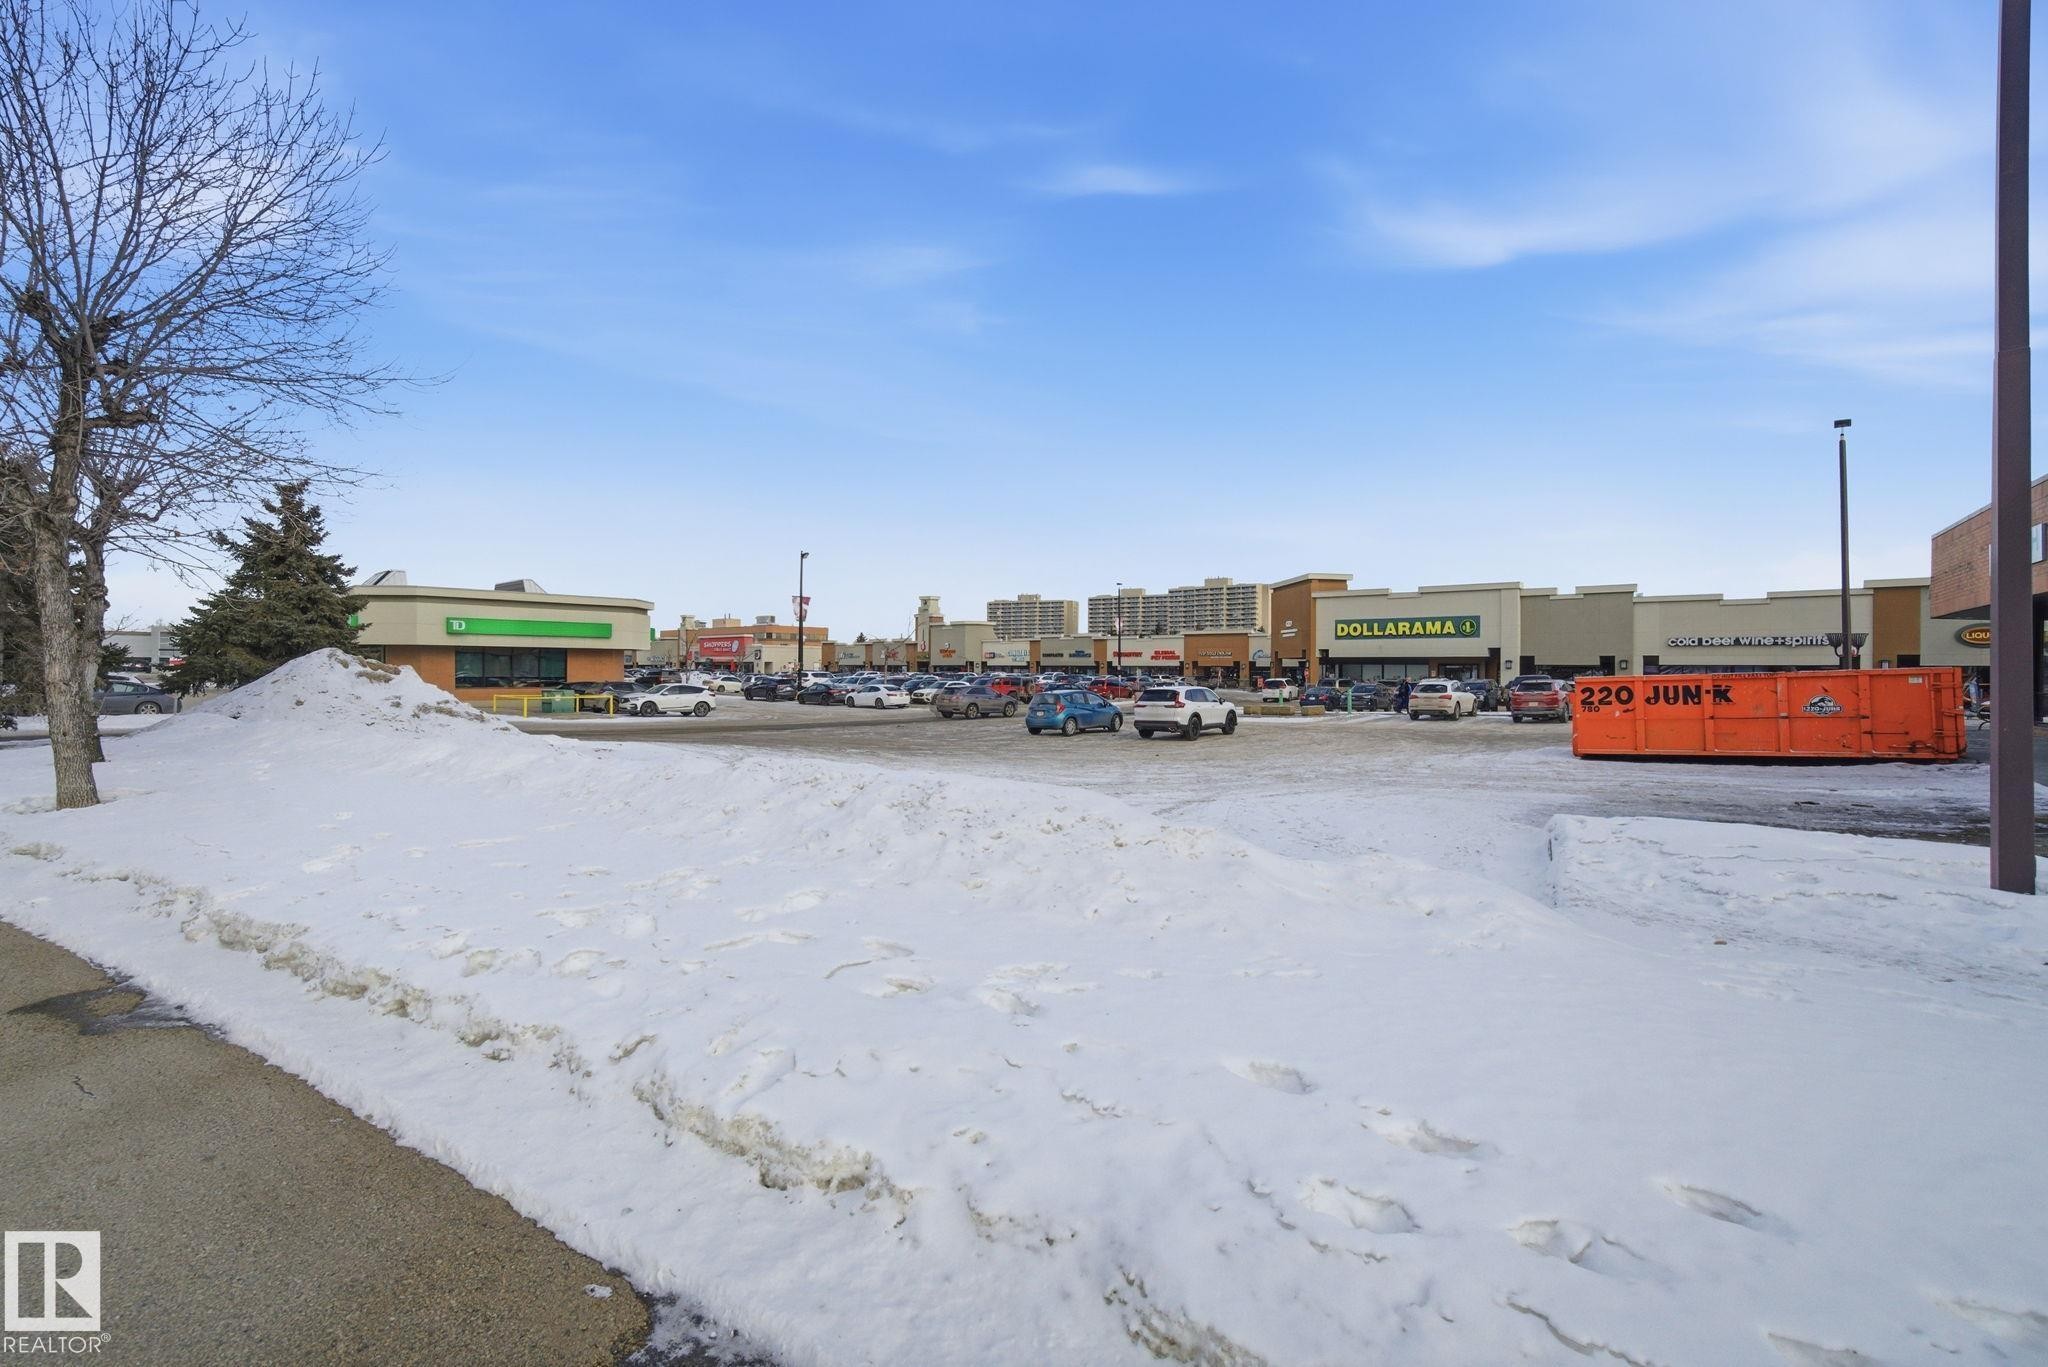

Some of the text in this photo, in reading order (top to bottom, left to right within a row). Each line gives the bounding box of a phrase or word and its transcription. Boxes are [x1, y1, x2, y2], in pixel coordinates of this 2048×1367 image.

[450, 620, 466, 631] TD
[1337, 621, 1455, 636] DOLLARAMA
[1668, 635, 1698, 647] cold
[1702, 635, 1736, 646] beer
[1580, 686, 1634, 706] 220
